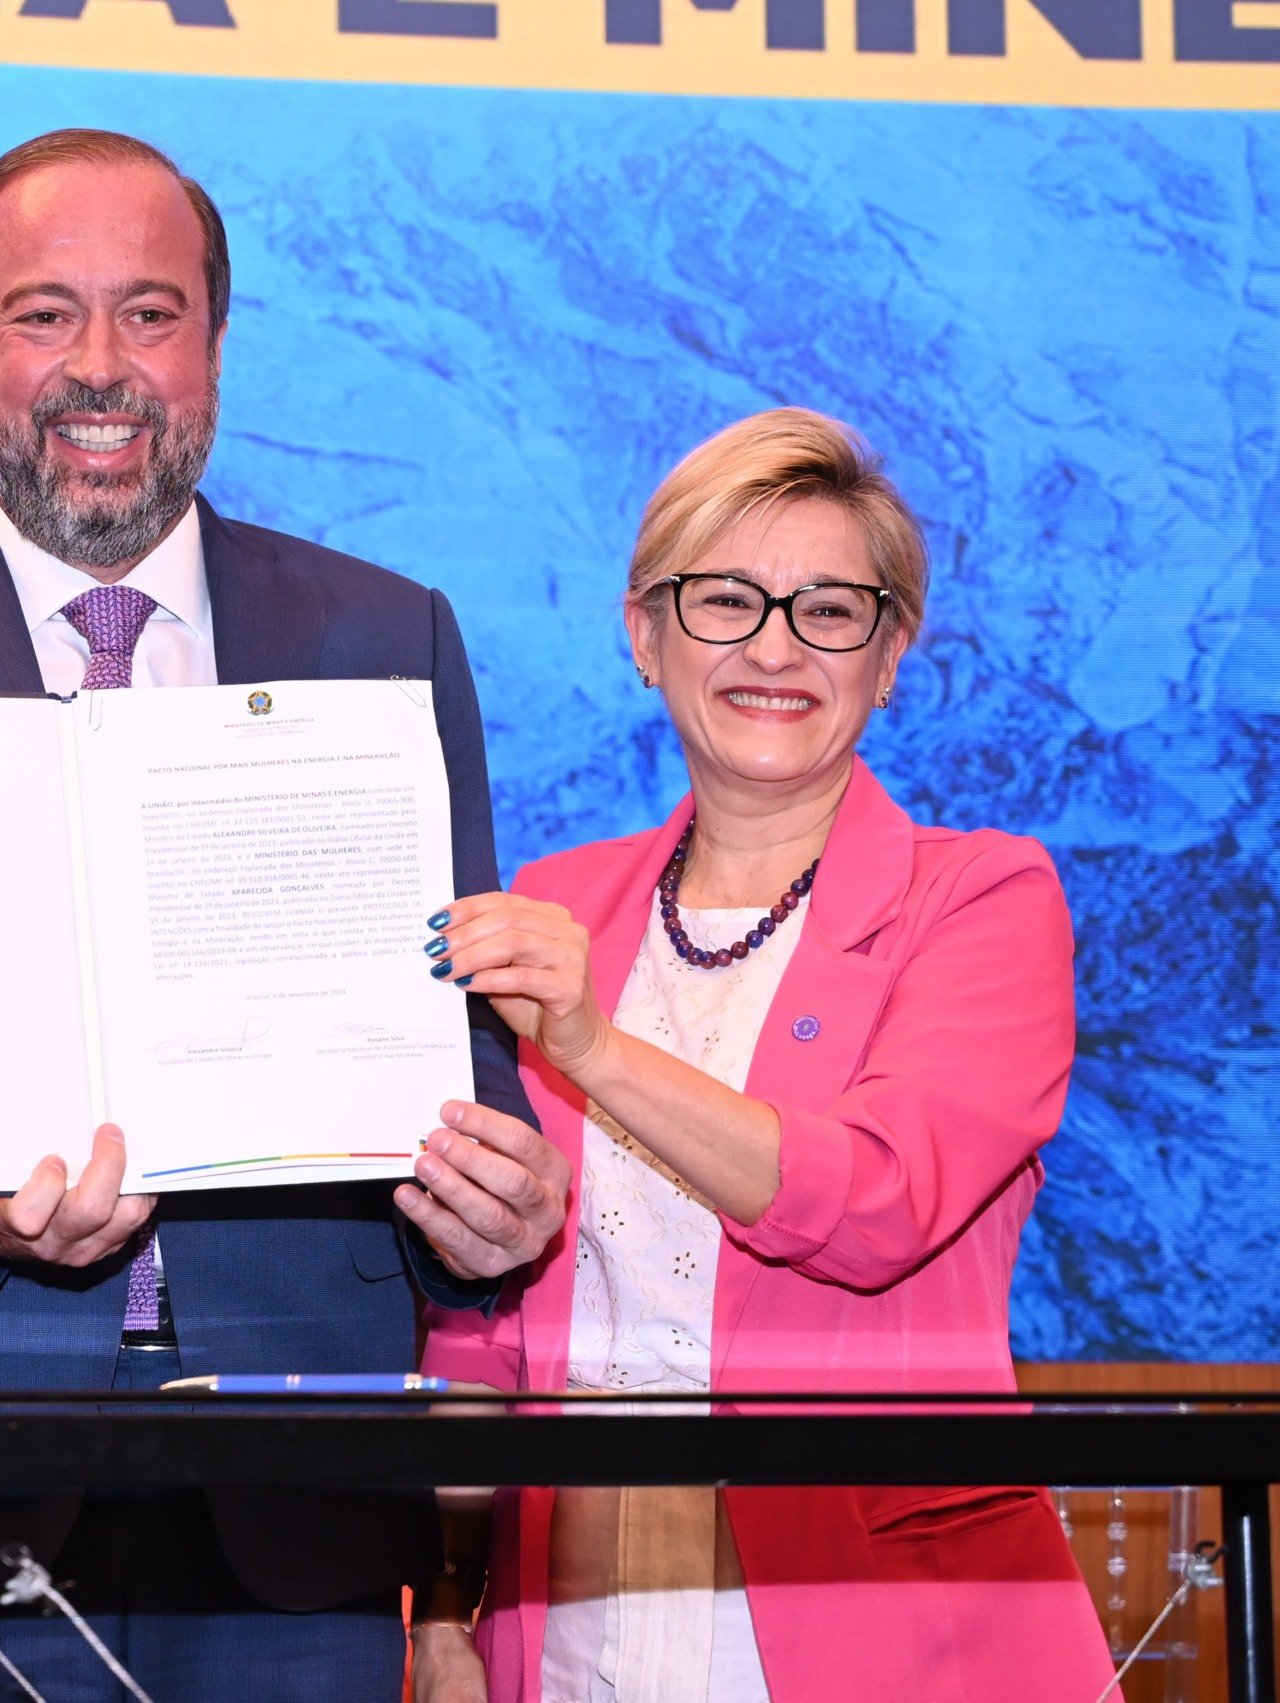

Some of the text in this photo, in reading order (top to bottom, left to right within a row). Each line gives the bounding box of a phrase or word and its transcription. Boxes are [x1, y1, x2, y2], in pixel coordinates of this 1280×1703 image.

[174, 764, 211, 772] NACIONAL
[250, 759, 290, 767] MULHERES
[304, 756, 335, 764] ENERGIA
[355, 752, 400, 761] MINERAÇÃO
[147, 800, 175, 810] UNIÃO,
[191, 797, 232, 806] intermédio
[244, 792, 288, 802] MINISTÉRIO
[301, 791, 327, 799] MINAS
[334, 788, 367, 796] ENERGIA
[212, 830, 256, 838] ALEXANDRE
[257, 828, 290, 836] SILVEIRA
[302, 825, 338, 834] OLIVEIRA,
[254, 850, 298, 859] MINISTÉRIO
[321, 846, 364, 857] MULHERES,
[231, 887, 273, 896] APARECIDA
[279, 884, 326, 894] GONÇALVES,
